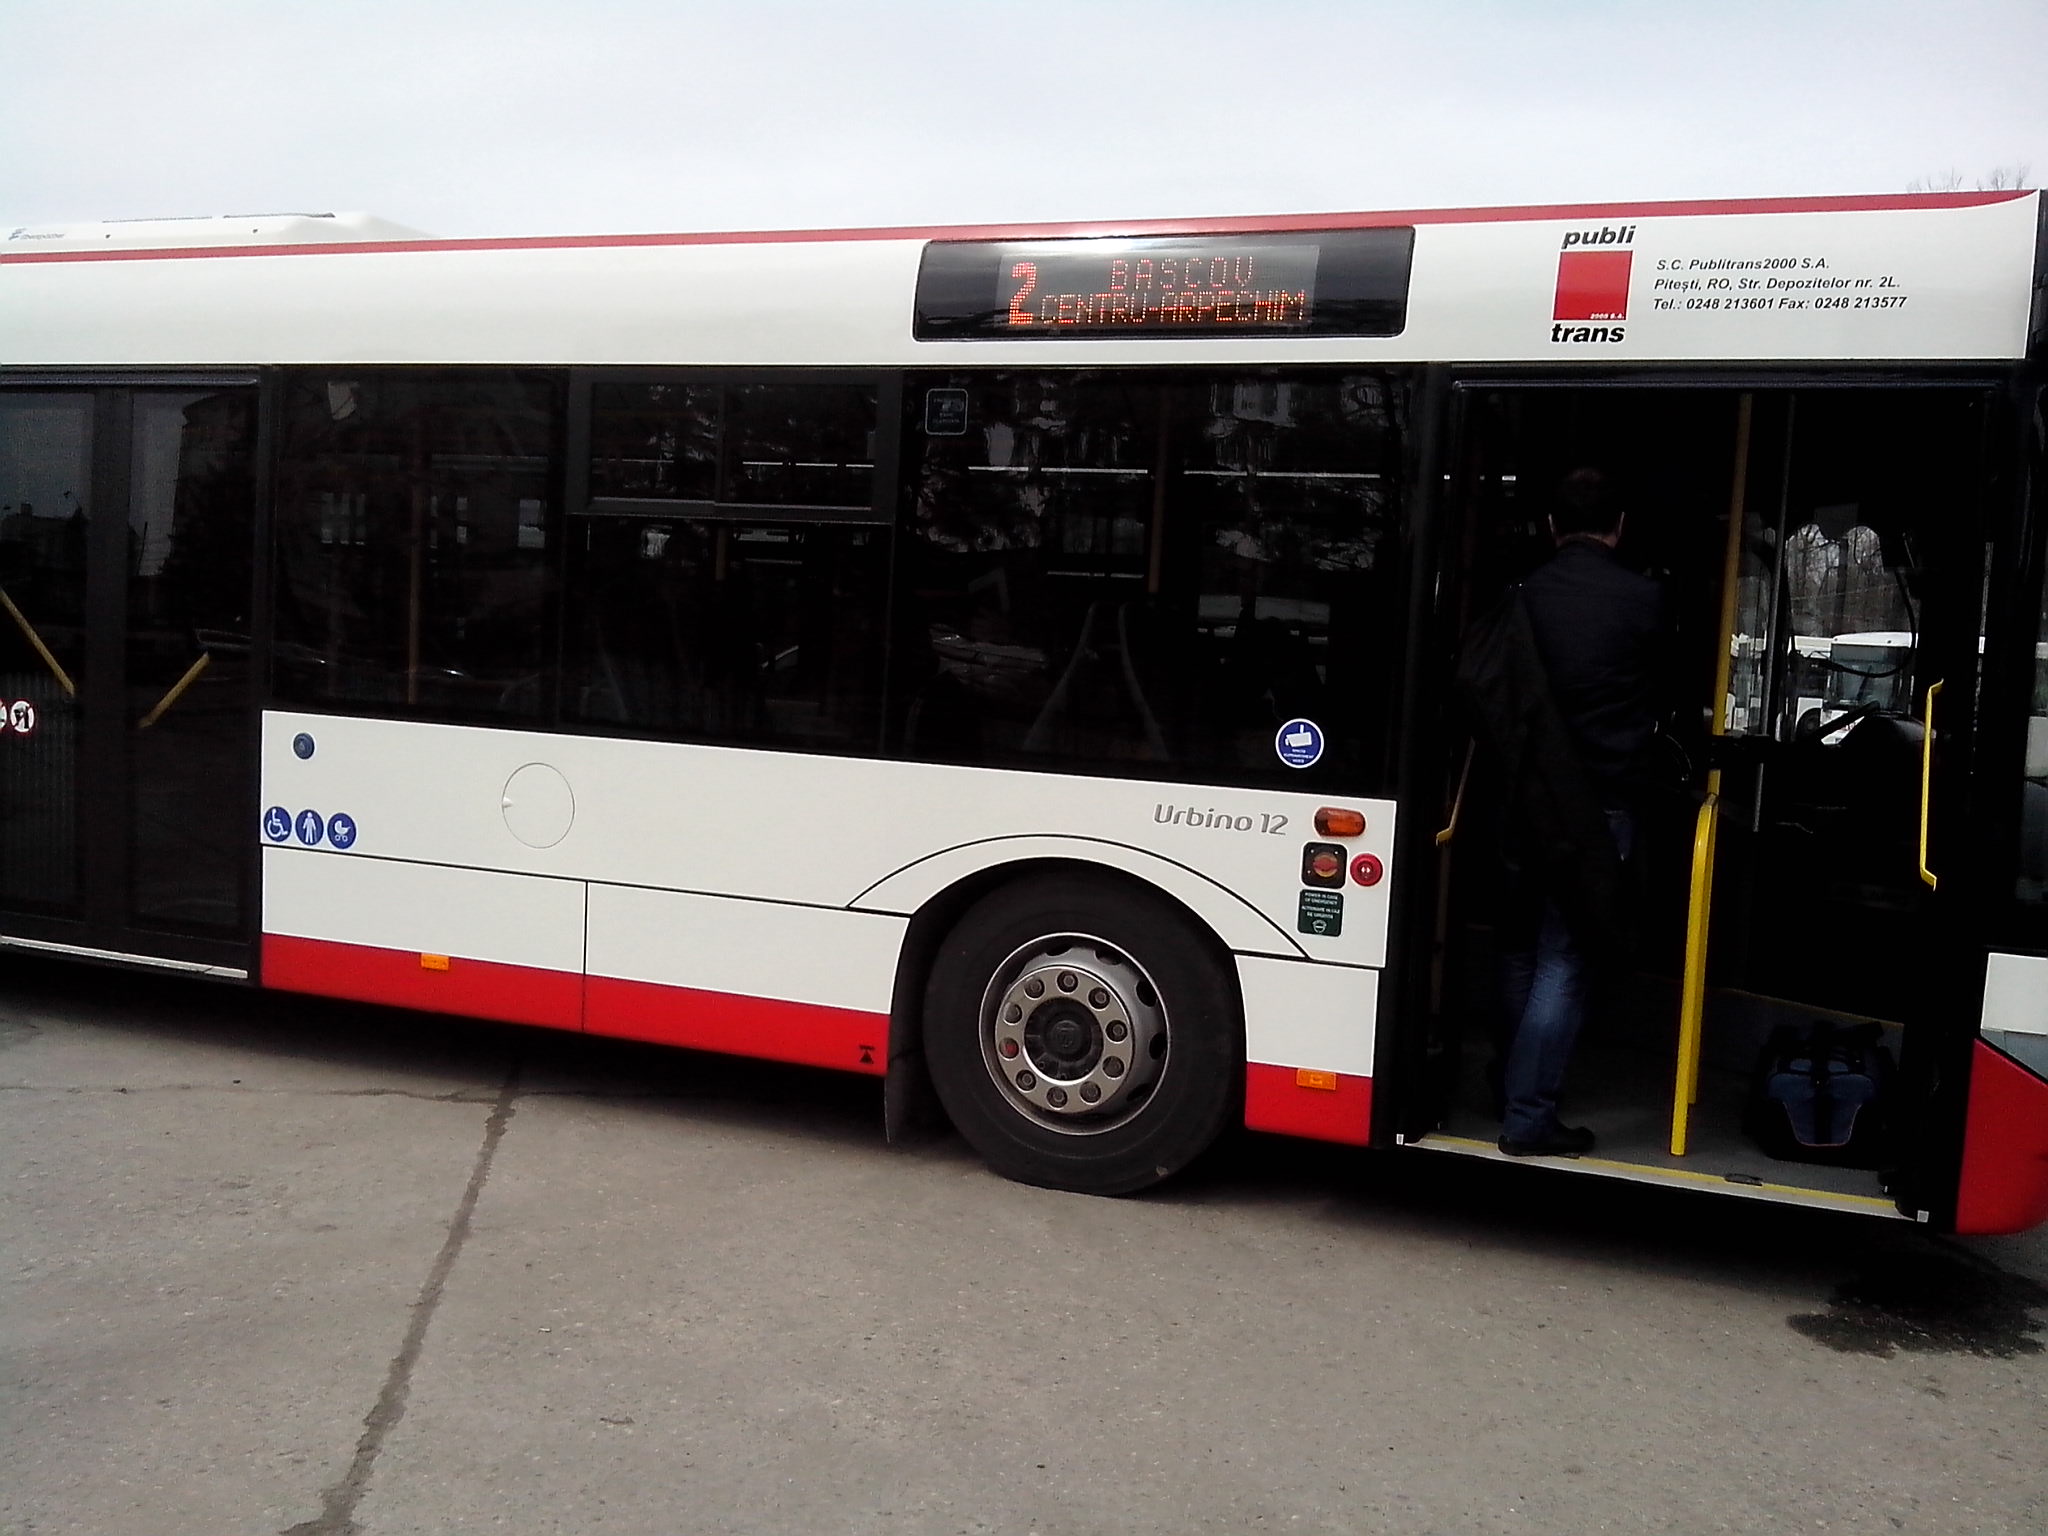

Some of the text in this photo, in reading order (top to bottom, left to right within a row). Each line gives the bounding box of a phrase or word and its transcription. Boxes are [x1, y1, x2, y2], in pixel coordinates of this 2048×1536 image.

[1561, 225, 1636, 249] publi
[1111, 256, 1253, 290] BASCOV
[1656, 257, 1829, 270] S.C. Publitrans2000 S.A.
[1009, 261, 1037, 325] 2
[1707, 277, 1732, 291] RO,
[1738, 278, 1761, 290] Str.
[1766, 276, 1851, 291] Depozitelor
[1855, 278, 1873, 288] nr.
[1879, 275, 1901, 288] 2L.
[1653, 296, 1907, 310] Tel.: 0248 213601 Fax: 0248 213577
[1551, 323, 1626, 343] trans
[1153, 803, 1290, 836] Urbino 12
